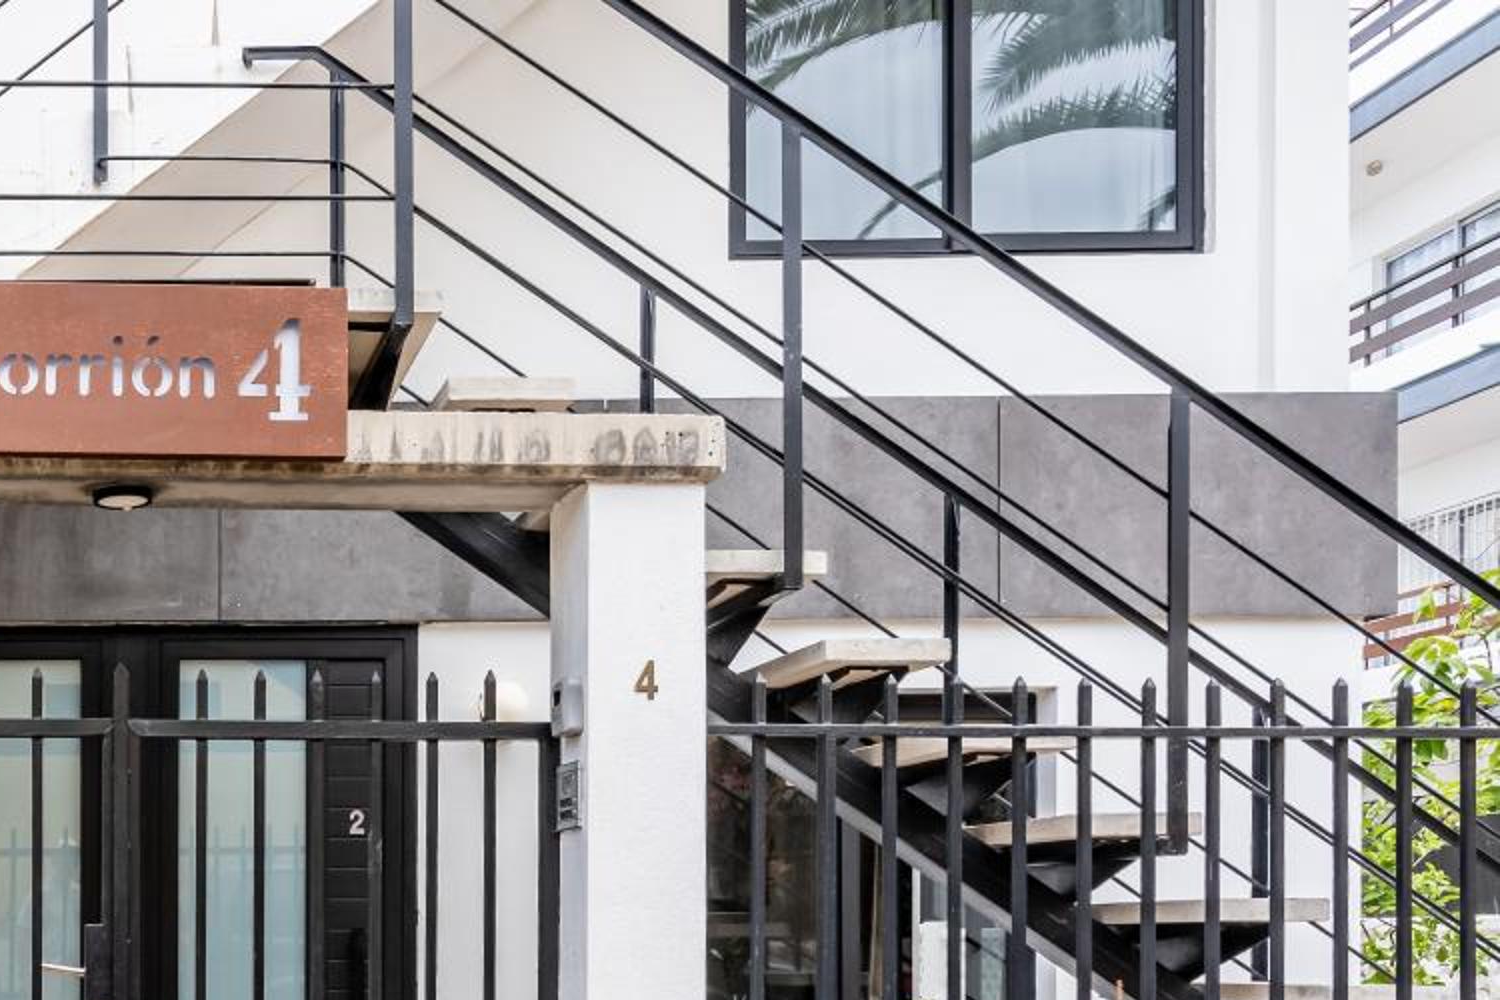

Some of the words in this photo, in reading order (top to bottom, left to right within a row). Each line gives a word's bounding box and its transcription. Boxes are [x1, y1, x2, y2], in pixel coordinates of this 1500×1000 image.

[237, 317, 312, 421] 4
[634, 659, 659, 700] 4
[348, 809, 366, 835] 2
